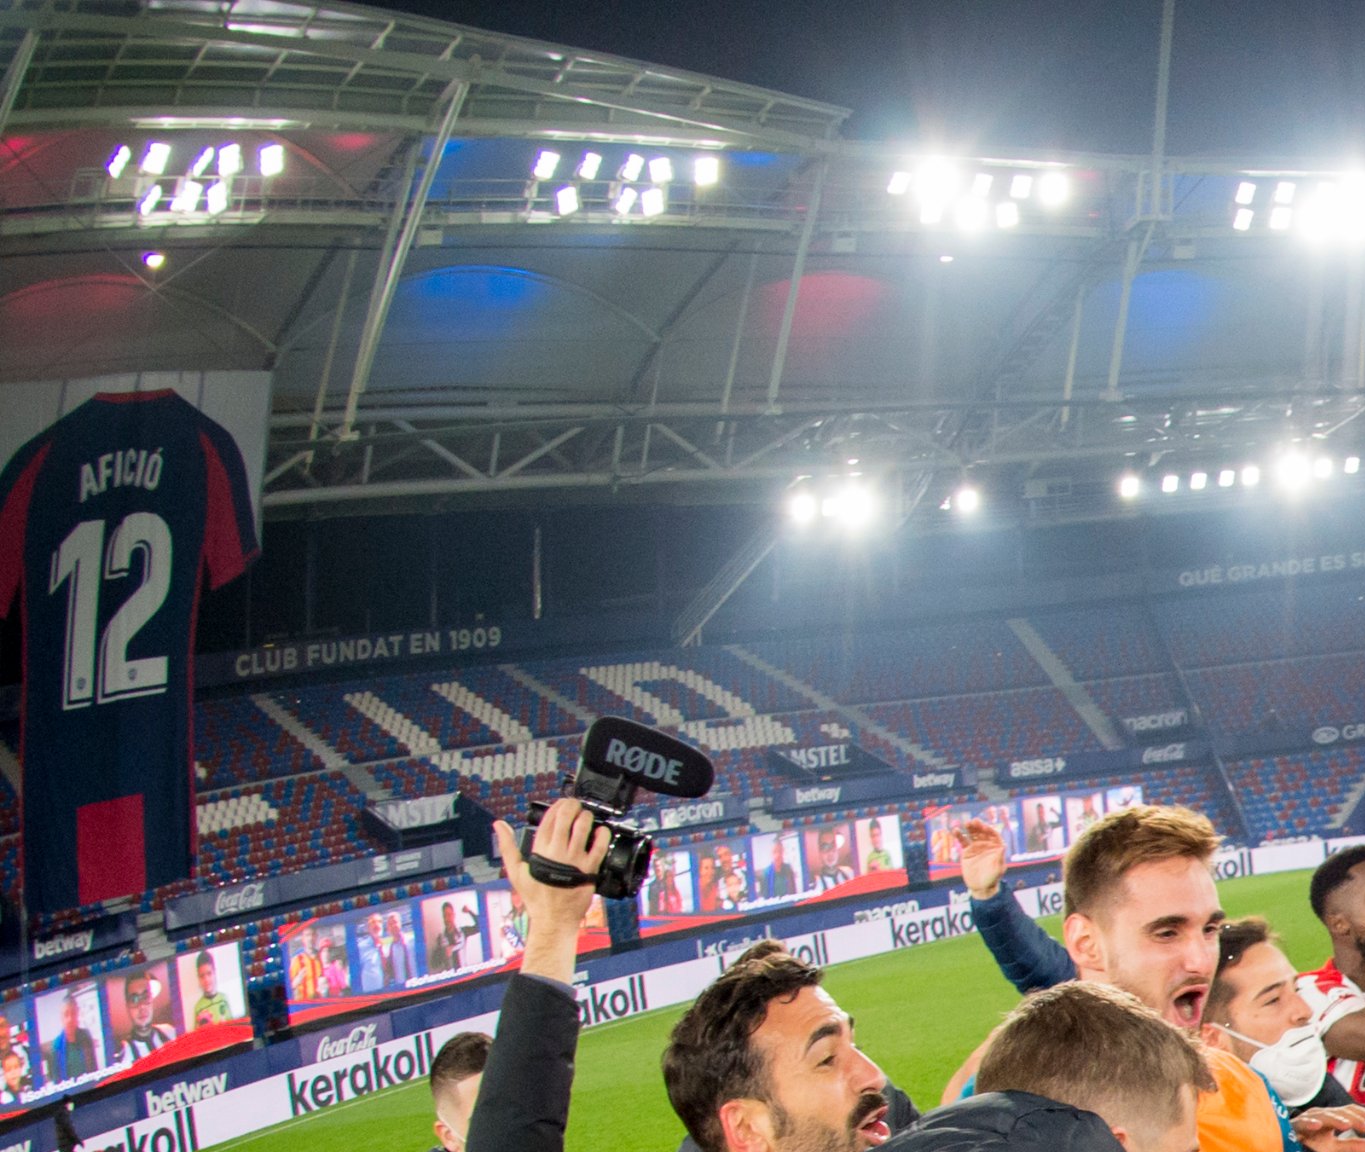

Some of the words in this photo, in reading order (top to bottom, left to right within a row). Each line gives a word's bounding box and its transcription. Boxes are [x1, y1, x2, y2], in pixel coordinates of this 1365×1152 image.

[80, 448, 164, 502] AFICIÓ
[1227, 557, 1317, 583] GRANDE
[1320, 554, 1347, 573] ES
[49, 512, 172, 711] 12
[235, 650, 297, 678] CLUB
[306, 632, 404, 666] FUNDAT
[409, 629, 440, 655] EN
[449, 625, 501, 651] 1909
[605, 738, 684, 786] RØDE
[1010, 758, 1054, 778] asisa
[795, 786, 842, 804] betway
[661, 801, 724, 830] macron
[34, 928, 94, 959] betway
[287, 1031, 434, 1117] kerakoll
